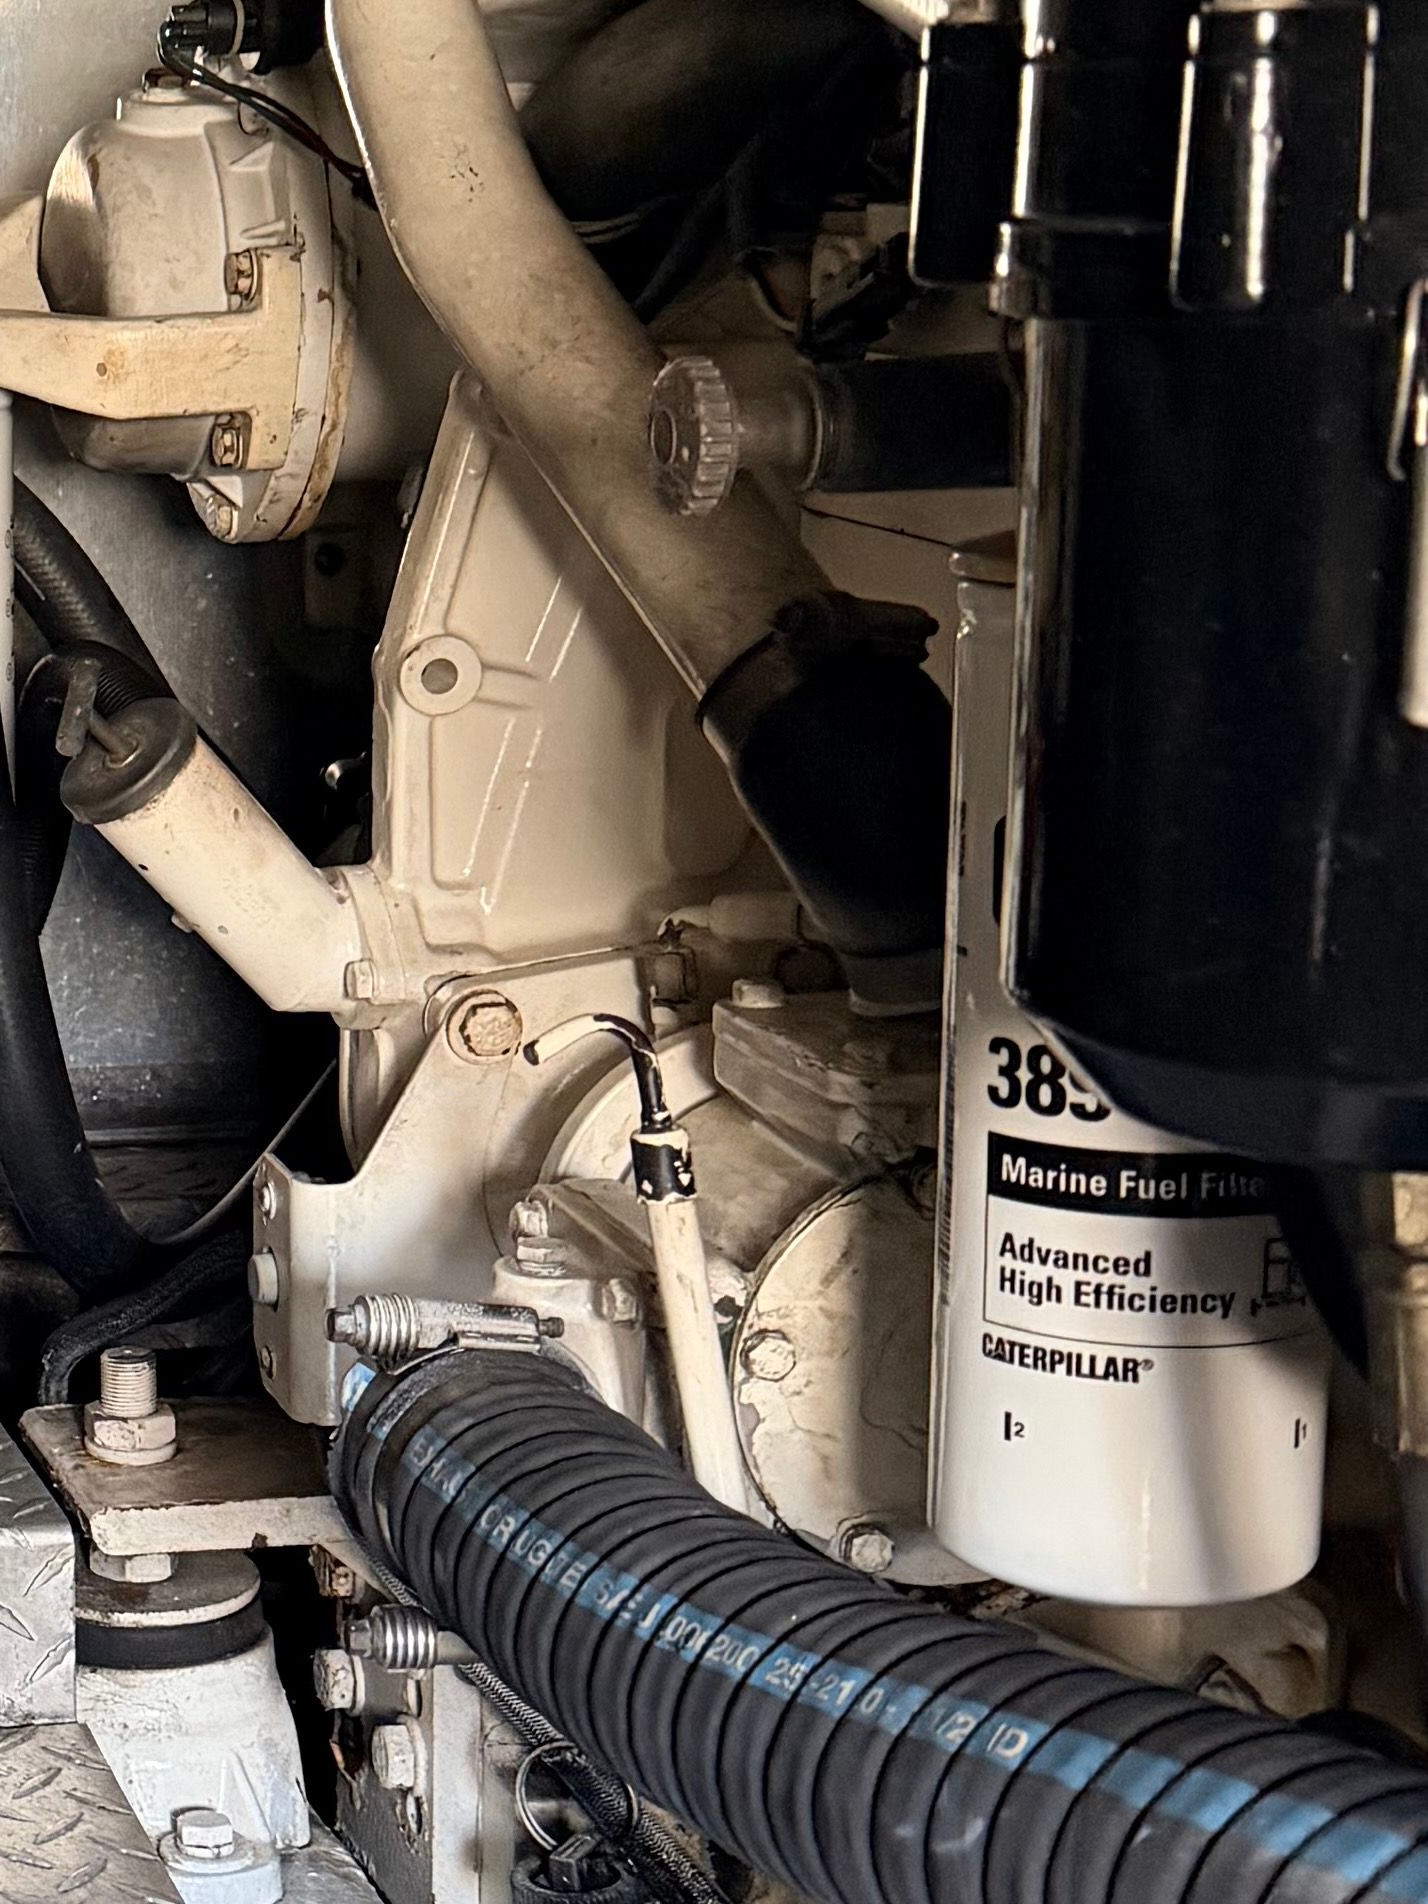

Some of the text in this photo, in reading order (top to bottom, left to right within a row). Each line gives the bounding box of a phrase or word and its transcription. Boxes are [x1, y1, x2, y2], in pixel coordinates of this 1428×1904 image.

[1000, 1152, 1267, 1202] Marine Fuel Filte
[998, 1231, 1153, 1278] Advanced
[998, 1265, 1237, 1320] High Efficiency
